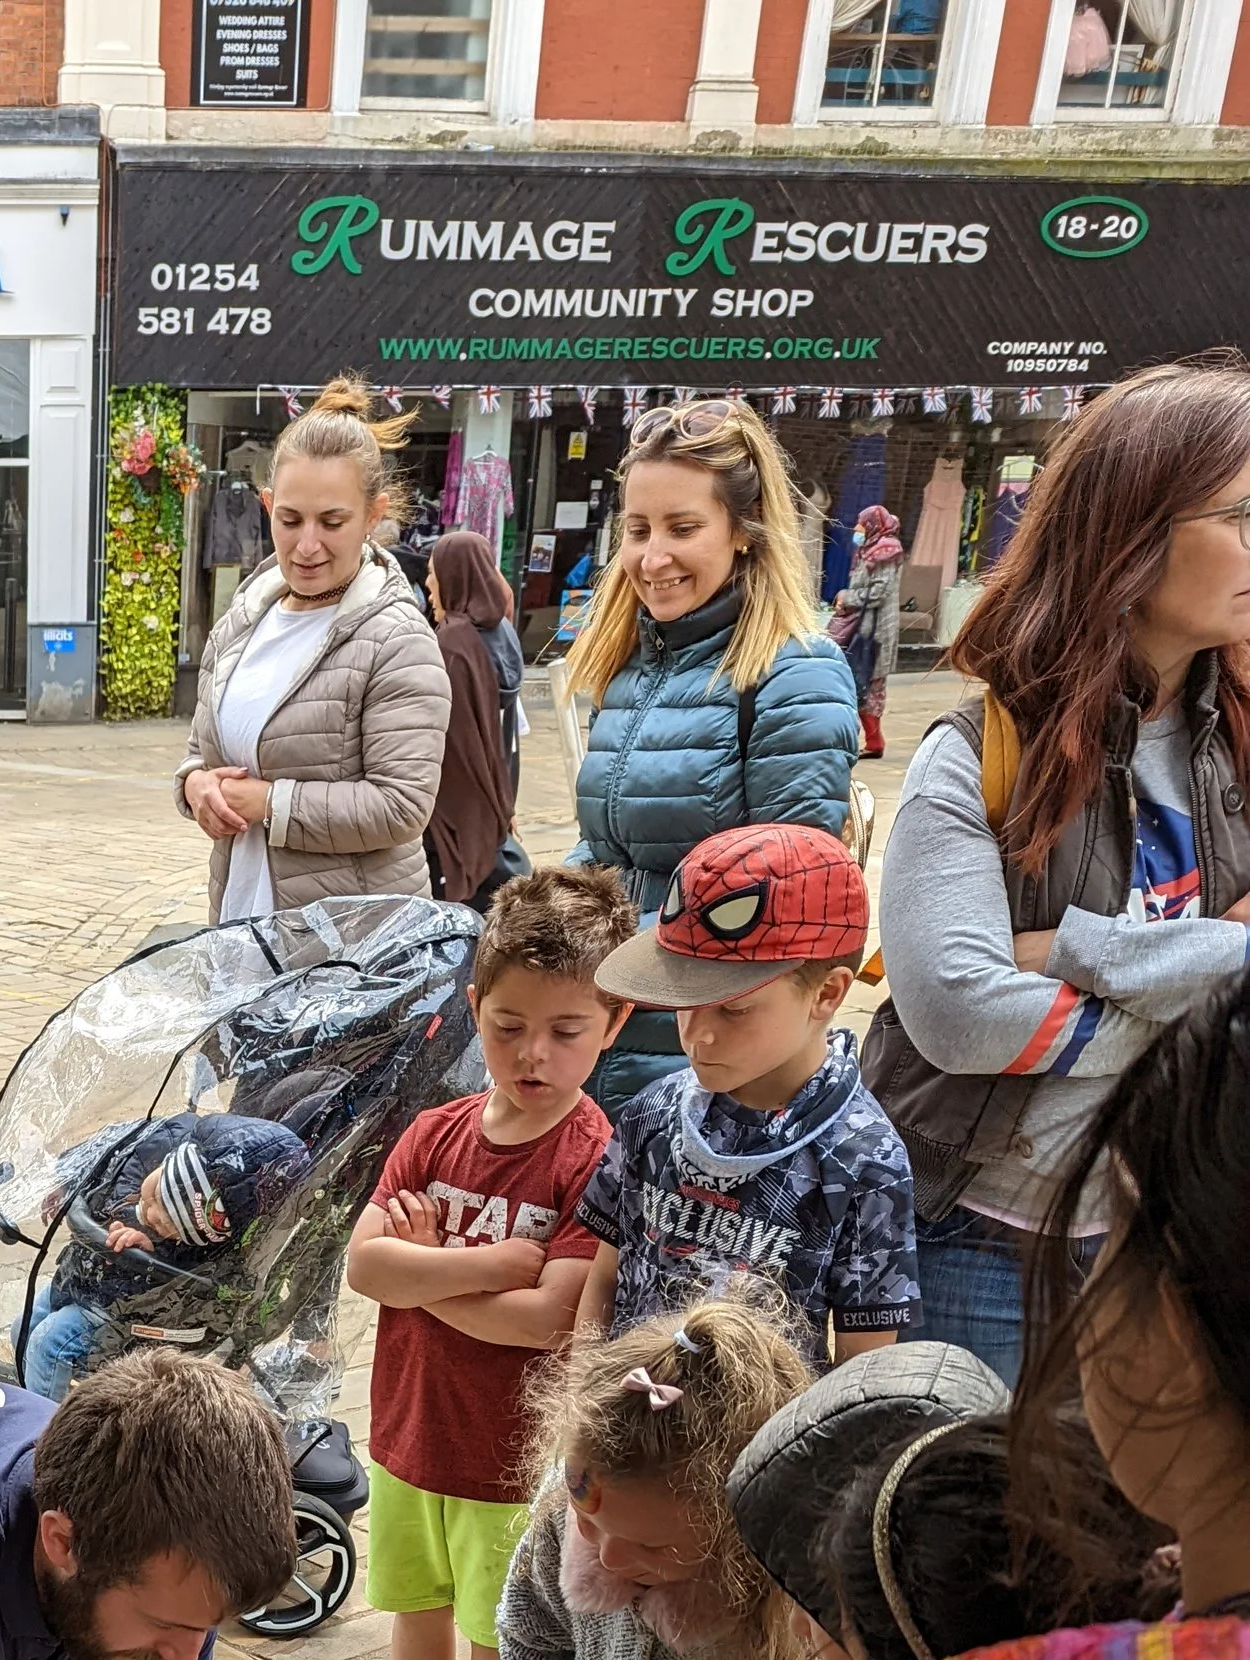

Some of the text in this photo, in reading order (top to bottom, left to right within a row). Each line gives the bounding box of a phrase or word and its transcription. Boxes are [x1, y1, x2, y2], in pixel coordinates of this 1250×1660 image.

[219, 15, 286, 26] WEDDING ATTIRE
[216, 29, 288, 40] EVENING DRESSES
[222, 43, 250, 54] SHOES
[256, 43, 280, 54] BAGS
[220, 55, 281, 67] PROM DRESSES
[235, 69, 259, 80] SUITS
[291, 194, 990, 278] RUMMAGE RESCUERS
[1056, 214, 1139, 239] 18-20
[151, 262, 260, 293] 01254
[468, 287, 815, 320] COMMUNITY SHOP
[137, 306, 272, 336] 581 478
[379, 336, 882, 361] WWW.RUMMAGERESCUERS.ORG.UK
[986, 340, 1109, 356] COMPANY NO.
[1004, 357, 1090, 374] 10950784
[642, 1181, 802, 1268] EXCLUSIVE
[843, 1307, 910, 1327] EXCLUSIVE
